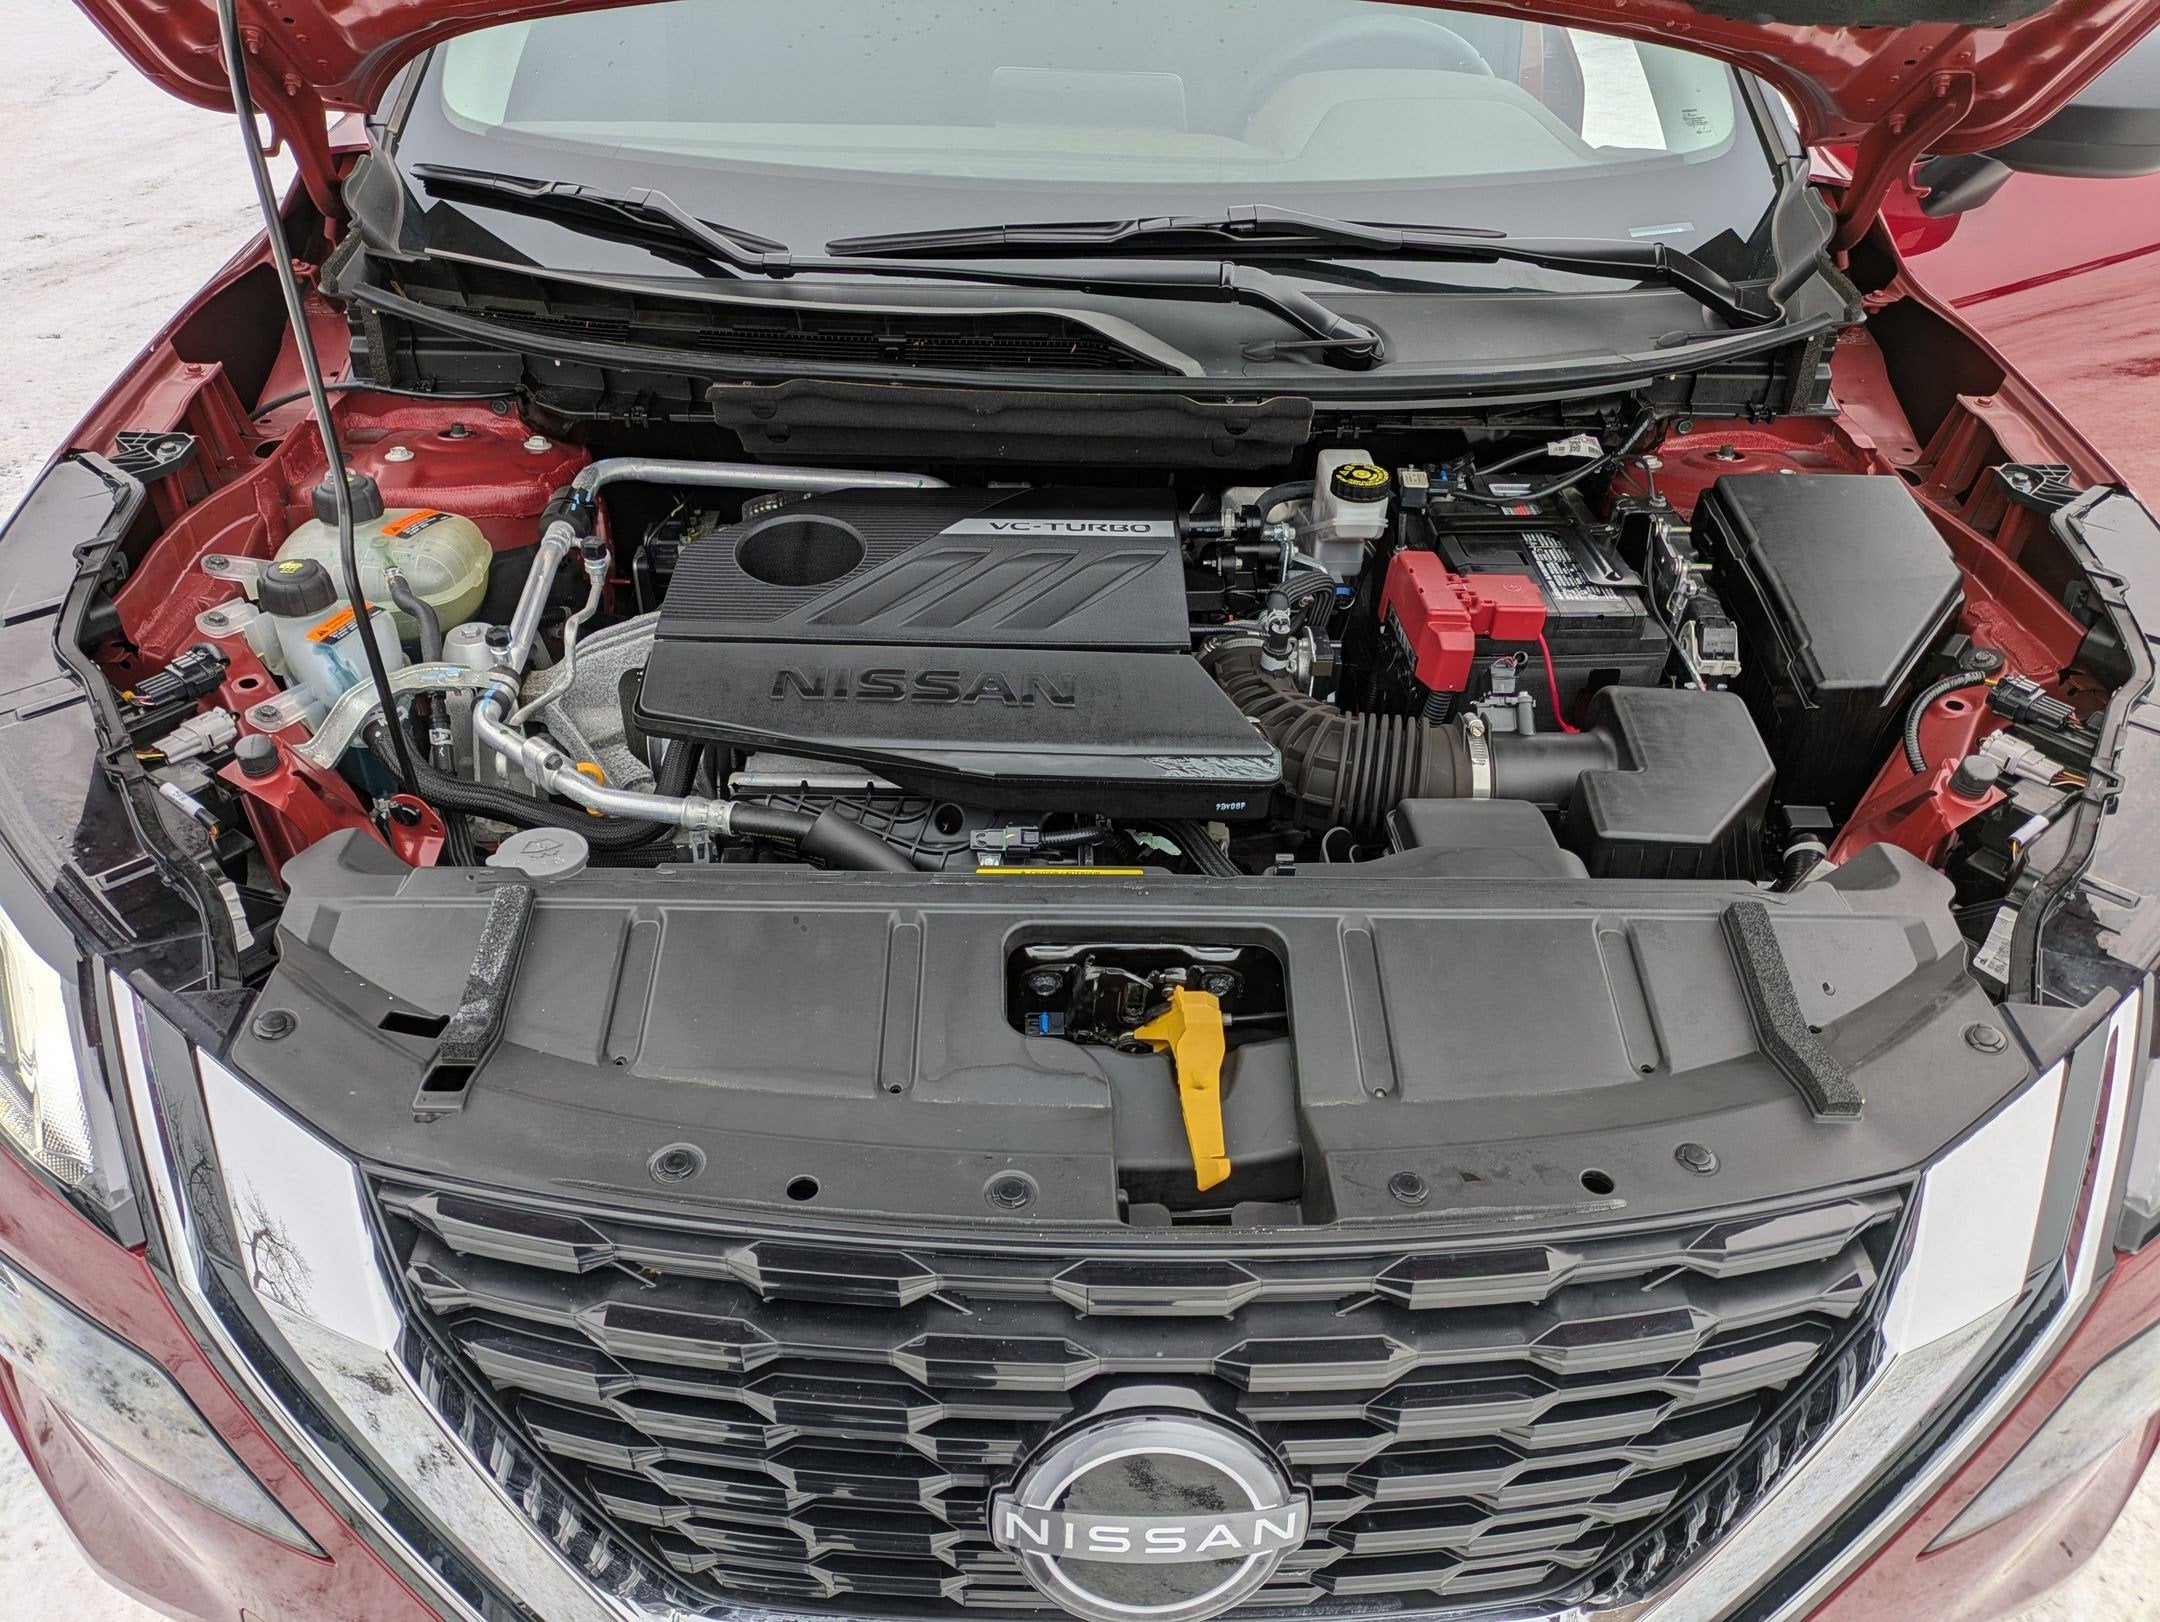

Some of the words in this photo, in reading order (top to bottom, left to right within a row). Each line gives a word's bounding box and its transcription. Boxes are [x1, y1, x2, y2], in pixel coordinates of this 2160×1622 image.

[989, 521, 1151, 534] VC-TURBO
[770, 667, 1076, 708] NISSAN
[1005, 1511, 1297, 1555] NISSAN
